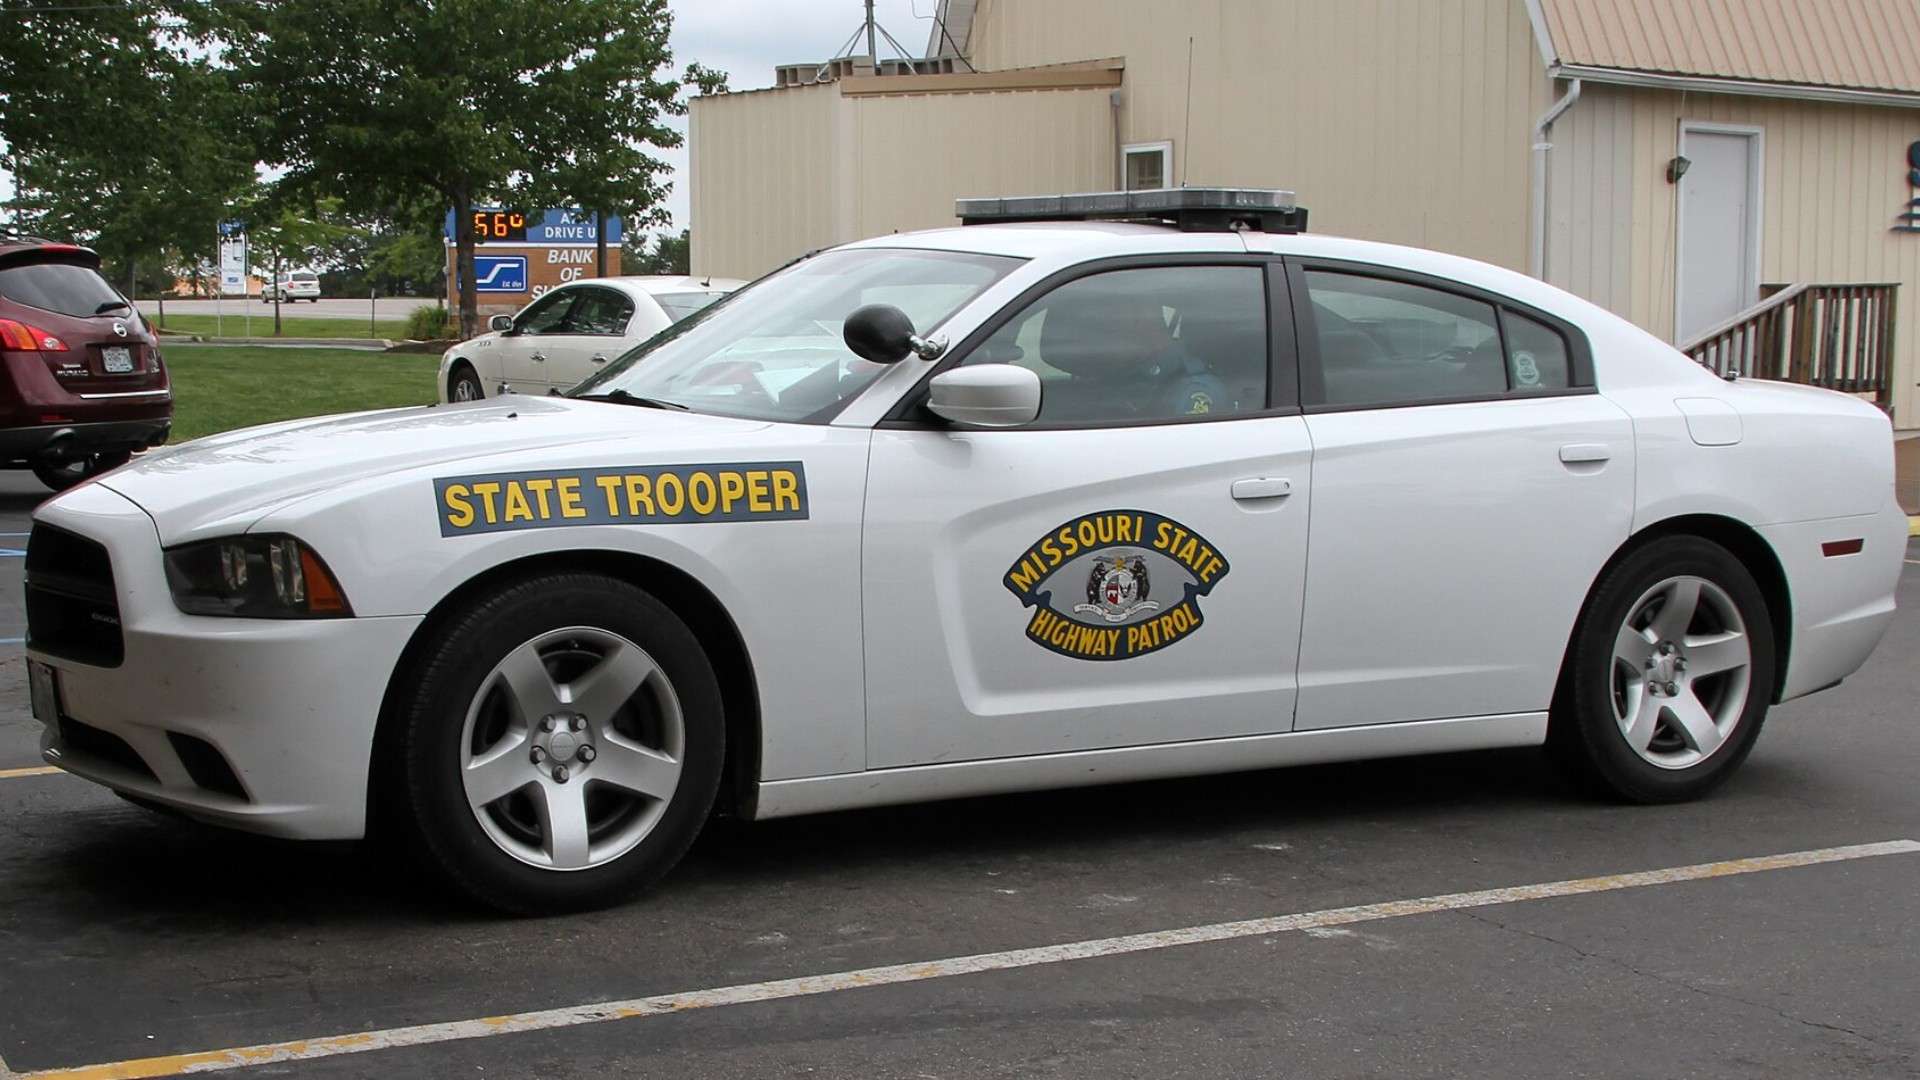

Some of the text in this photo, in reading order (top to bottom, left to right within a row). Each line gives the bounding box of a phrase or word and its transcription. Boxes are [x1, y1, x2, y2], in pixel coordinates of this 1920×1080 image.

[545, 226, 584, 238] DRIVE
[547, 249, 594, 263] BANK
[560, 267, 583, 281] OF
[444, 470, 800, 528] STATE TROOPER
[1009, 515, 1223, 593] MISSOURI STATE
[1030, 602, 1199, 656] HIGHWAY PATROL
